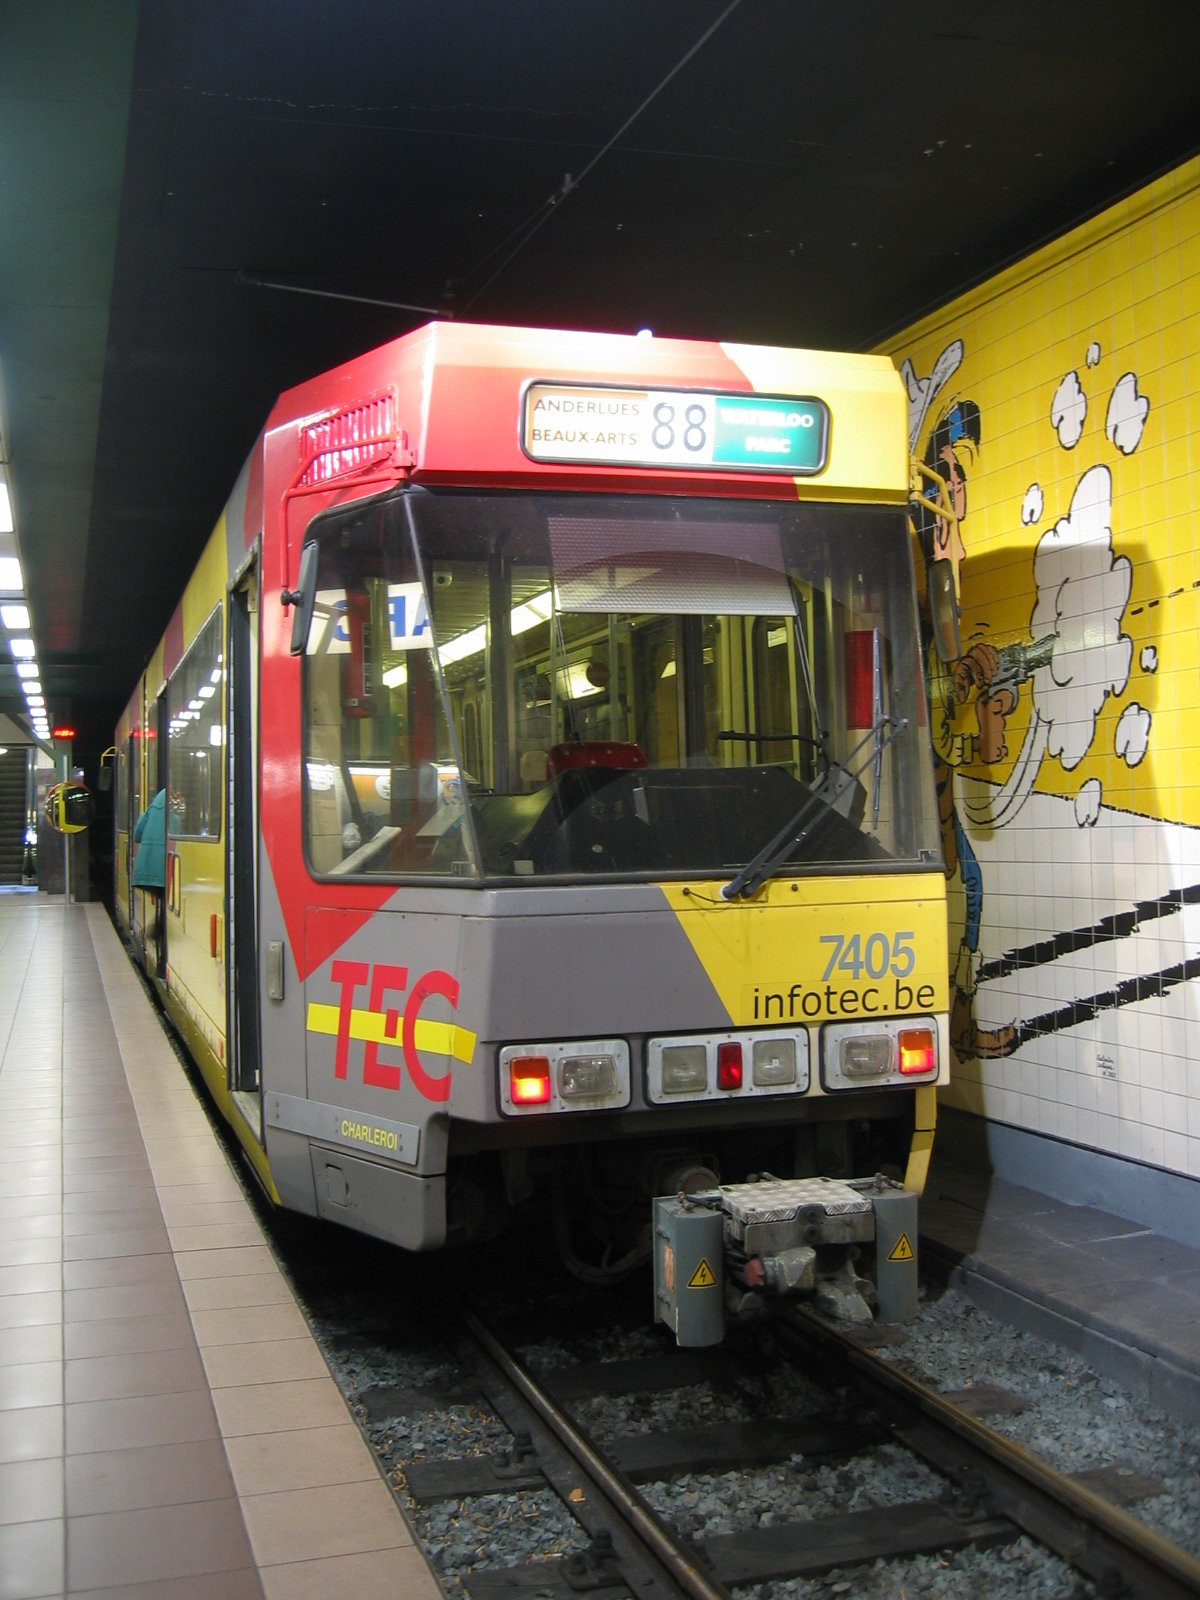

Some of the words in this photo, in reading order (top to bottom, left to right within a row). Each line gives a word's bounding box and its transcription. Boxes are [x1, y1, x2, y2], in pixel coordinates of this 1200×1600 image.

[533, 398, 641, 416] ANDERLUES
[651, 401, 708, 452] 88
[531, 428, 638, 446] BEAUX-ARTS
[819, 931, 916, 982] 7405
[753, 978, 936, 1020] infotec.be
[330, 959, 461, 1103] TEC
[340, 1119, 398, 1151] CHARLEROI
